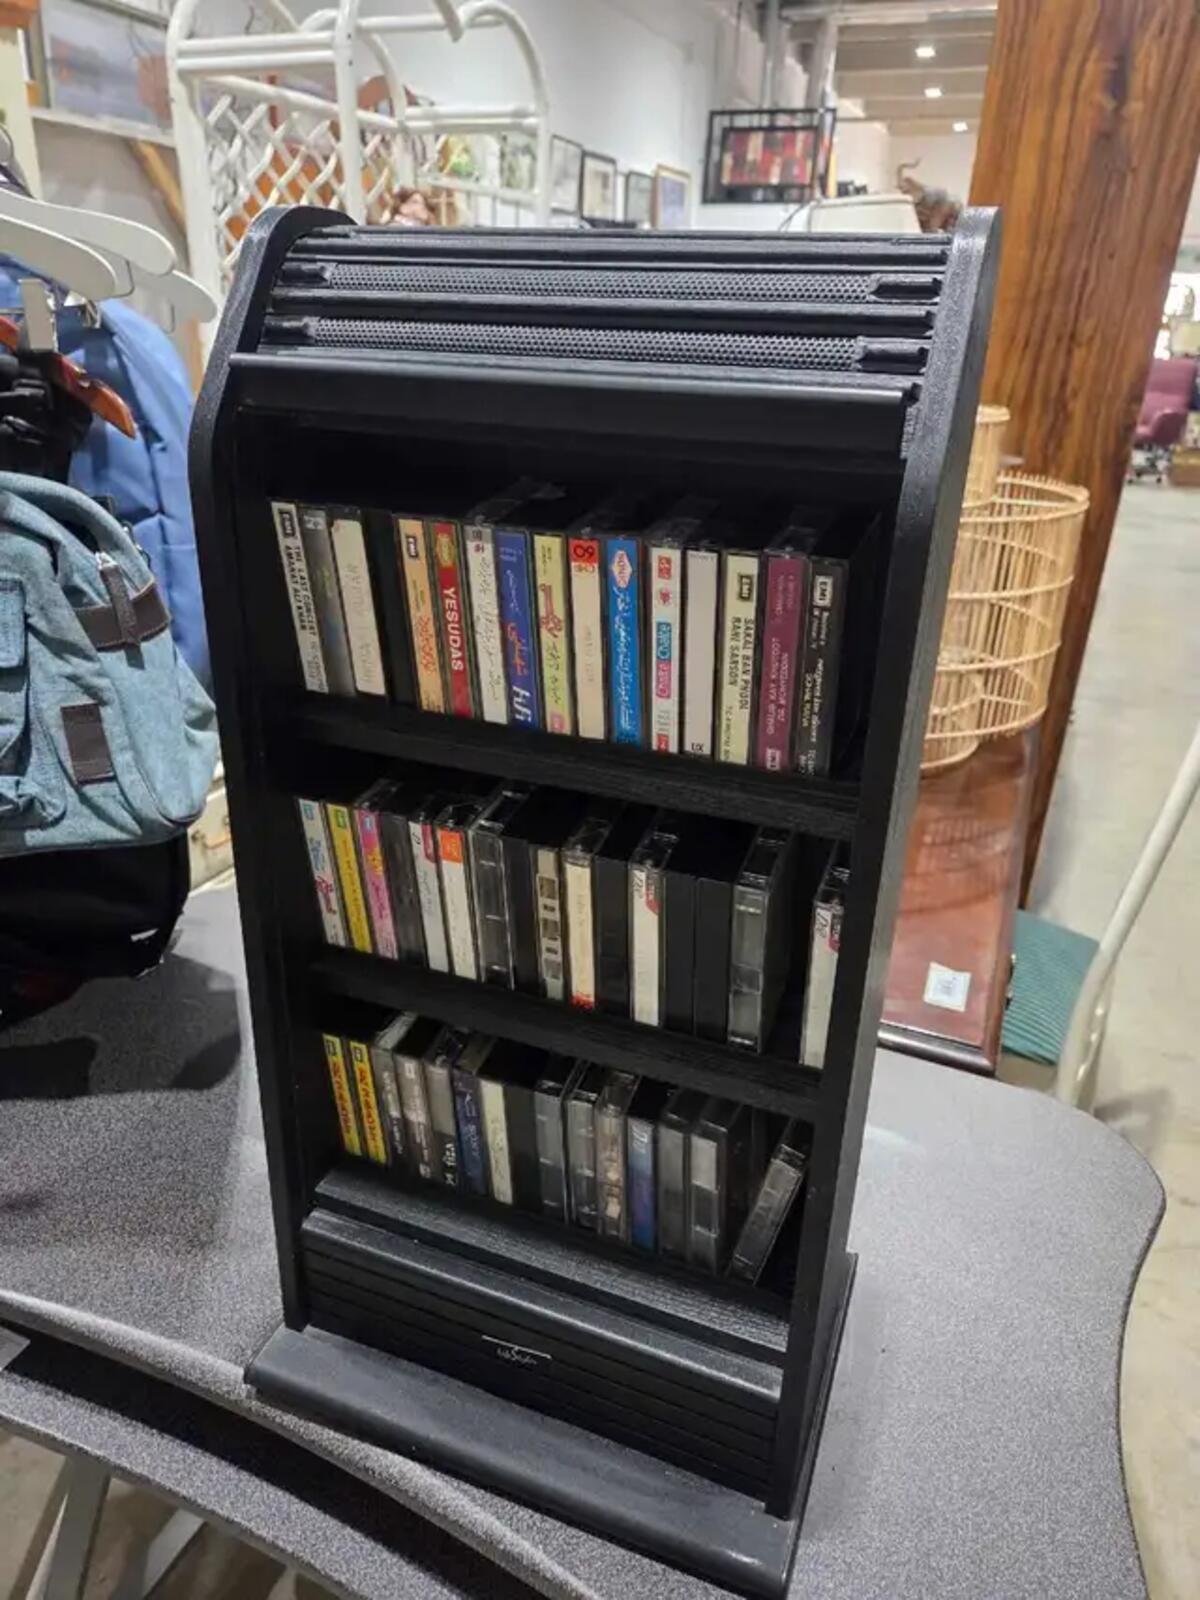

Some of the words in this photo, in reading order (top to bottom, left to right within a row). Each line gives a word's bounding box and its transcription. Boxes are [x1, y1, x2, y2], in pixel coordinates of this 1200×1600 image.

[297, 568, 308, 591] LAST
[302, 595, 315, 635] CONCERT
[442, 586, 464, 670] YESUDAS
